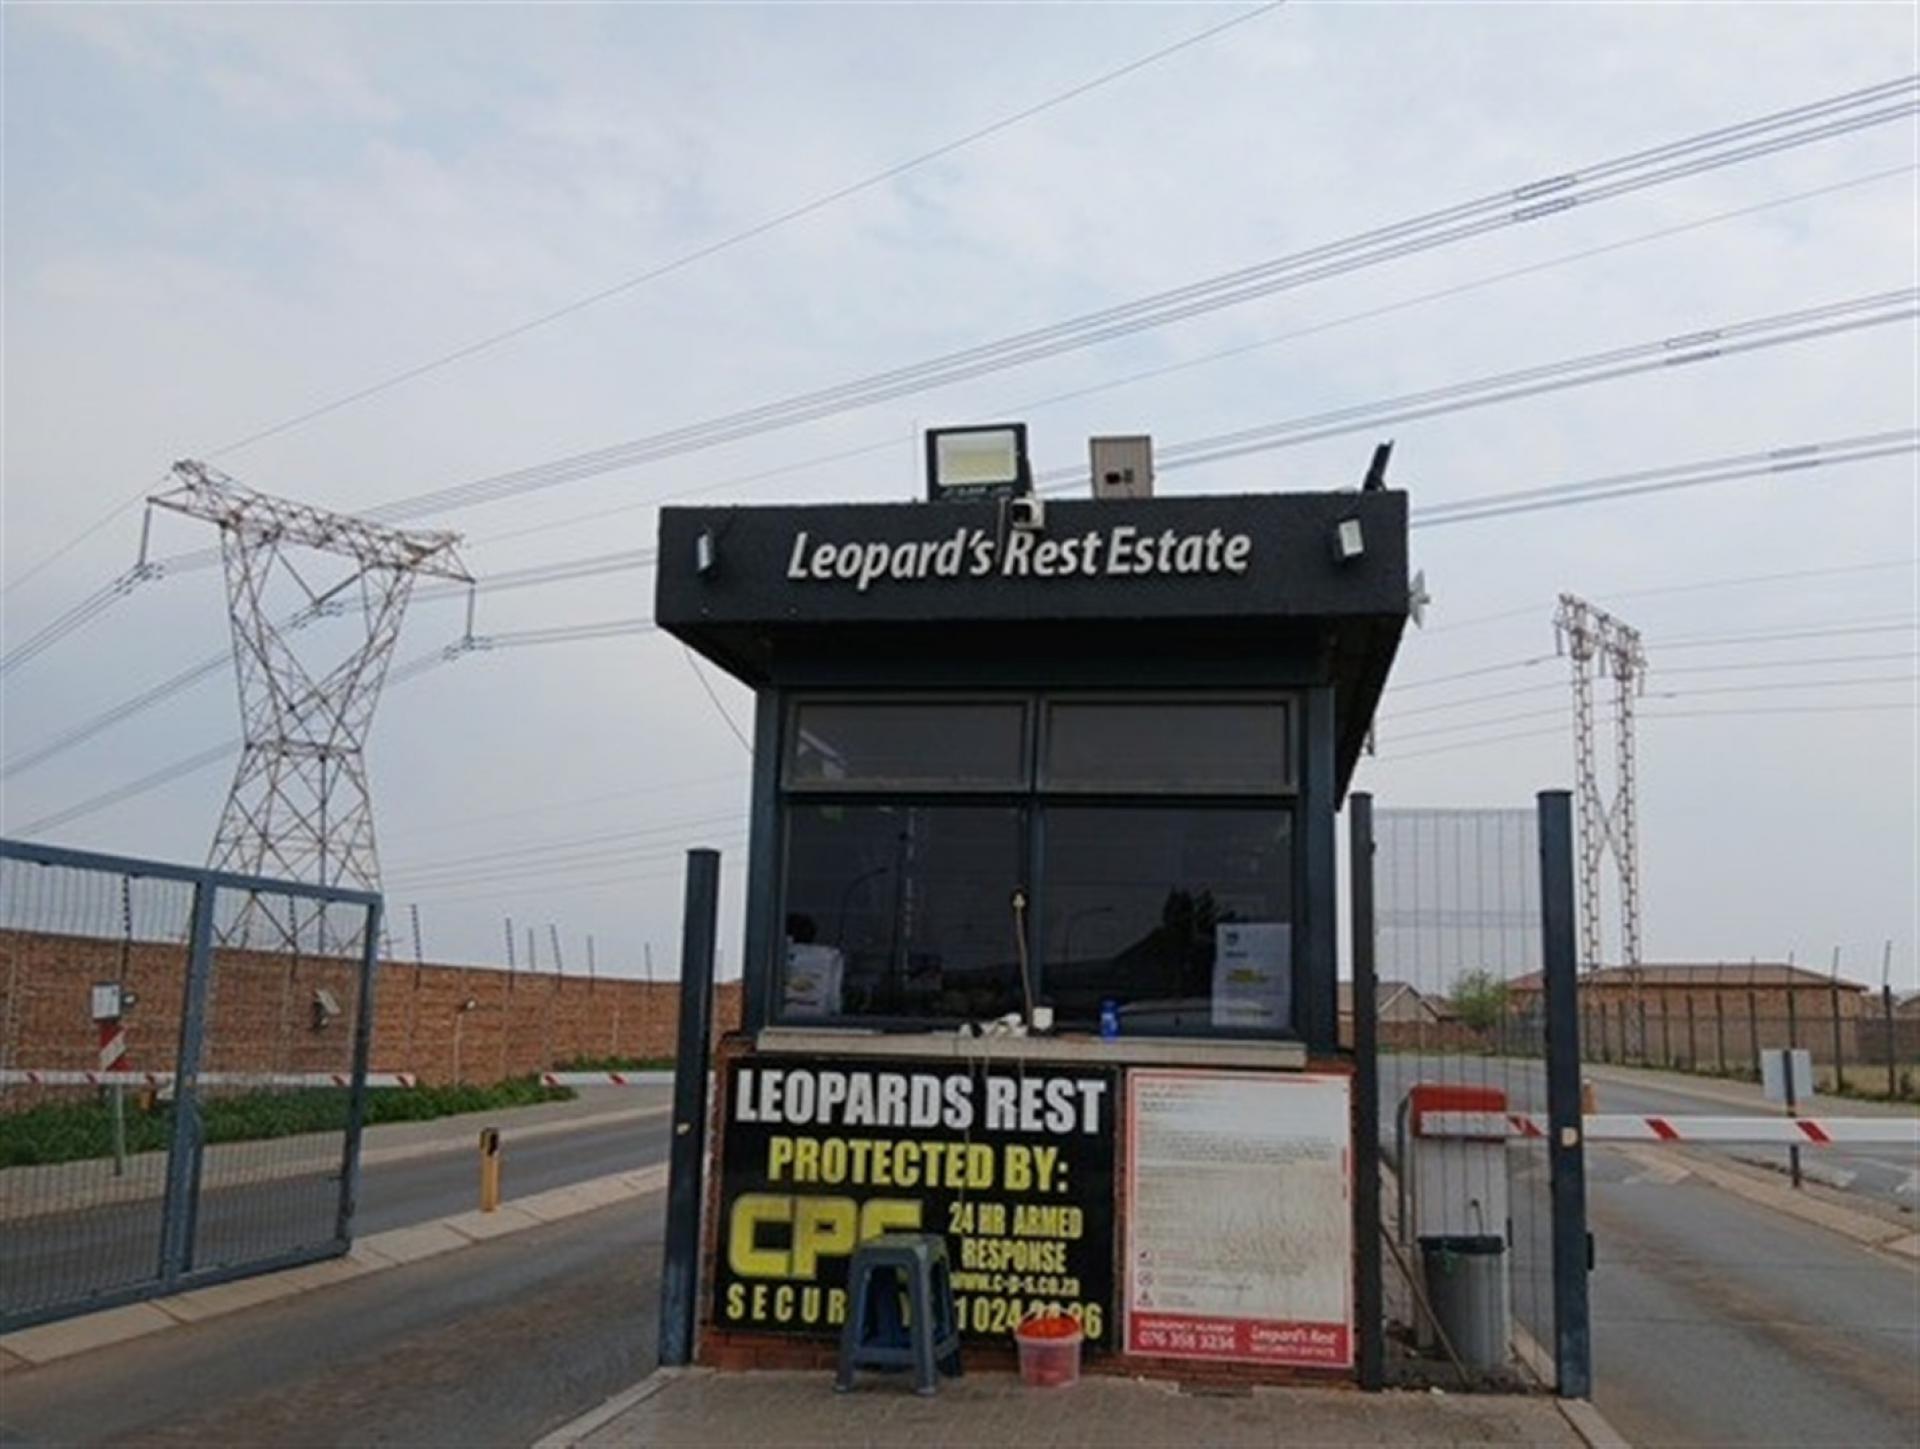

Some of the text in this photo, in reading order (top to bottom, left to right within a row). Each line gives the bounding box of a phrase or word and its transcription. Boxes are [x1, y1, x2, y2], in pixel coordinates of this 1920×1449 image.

[1002, 527, 1102, 579] Rest
[1107, 526, 1250, 577] Estate
[735, 1069, 1107, 1133] LEOPARDS REST
[768, 1136, 1068, 1193] PROTECTED BY:
[949, 1202, 1084, 1239] 24 HR ARMED
[962, 1237, 1067, 1273] RESPONSE
